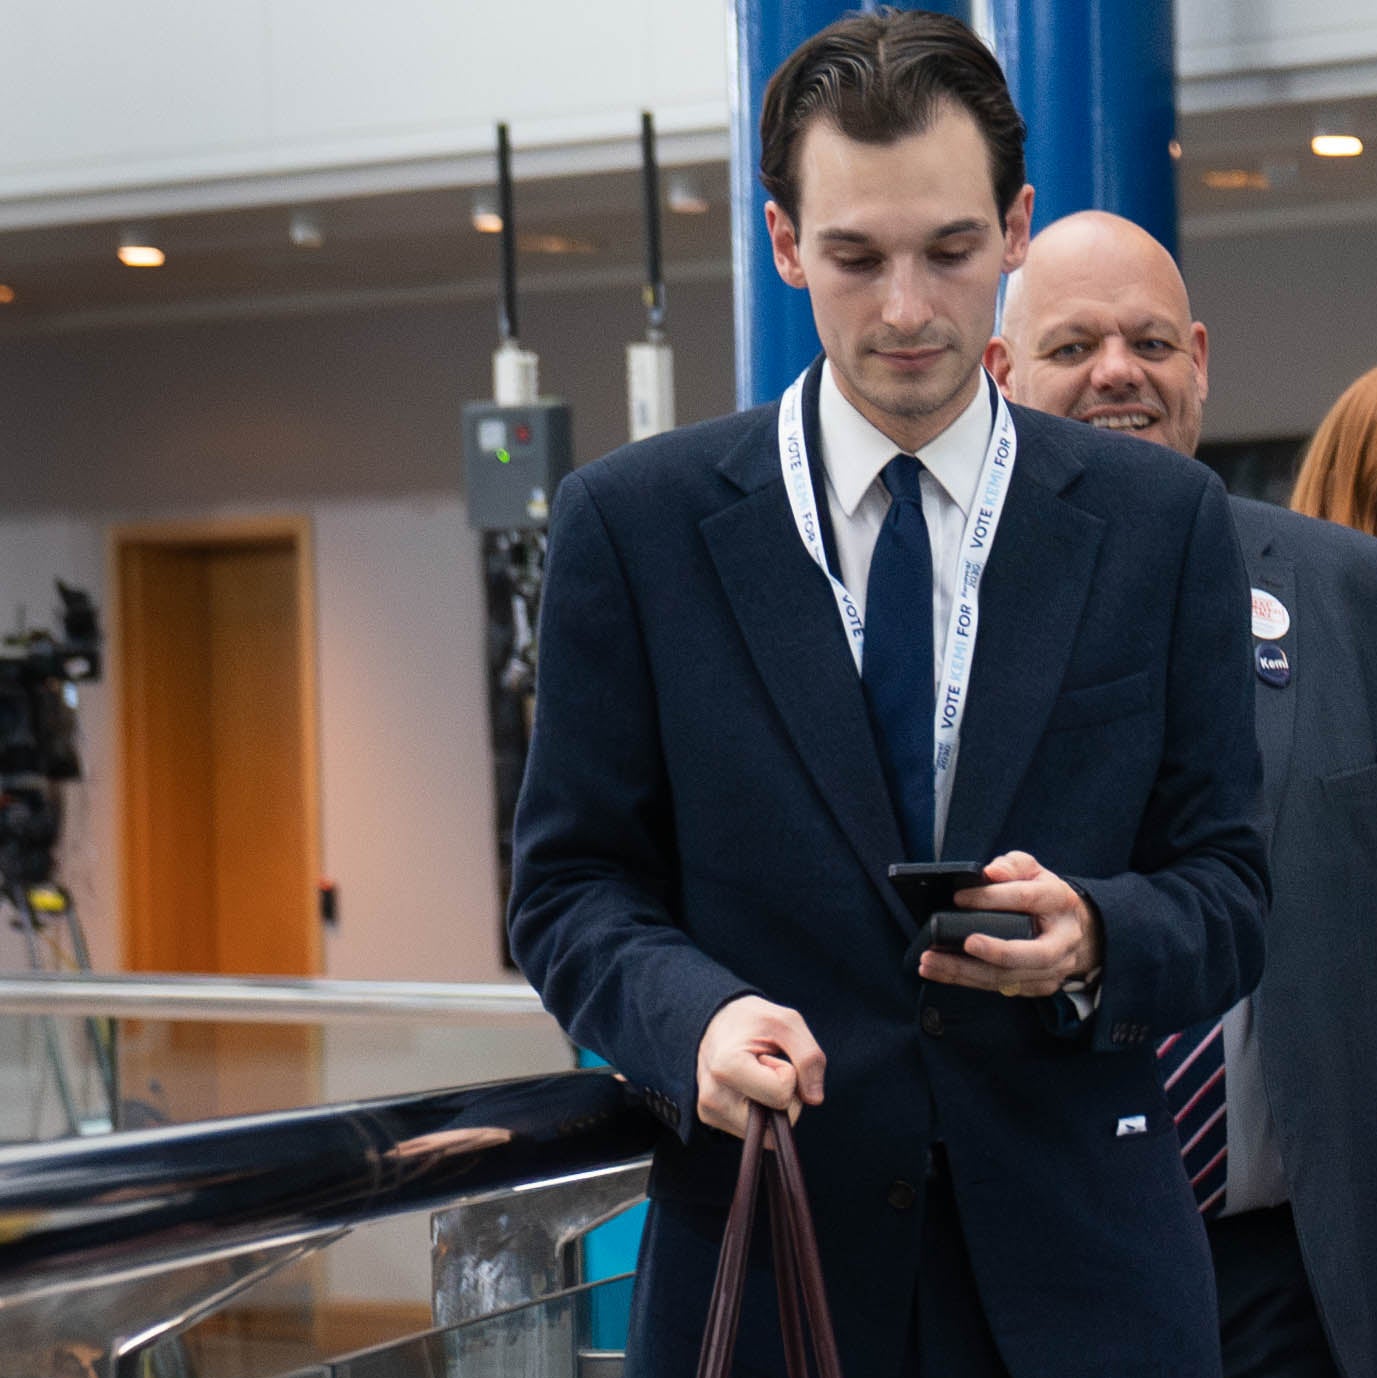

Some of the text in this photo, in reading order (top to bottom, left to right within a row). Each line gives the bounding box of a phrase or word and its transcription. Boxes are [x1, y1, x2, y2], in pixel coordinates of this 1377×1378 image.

[787, 431, 802, 471] VOTE
[802, 511, 815, 542] FOR
[970, 508, 993, 548] VOTE
[983, 468, 1005, 506] KEMI
[994, 438, 1011, 468] FOR
[842, 594, 864, 638] VOTE
[941, 604, 971, 729] VOTE KEMI FOR
